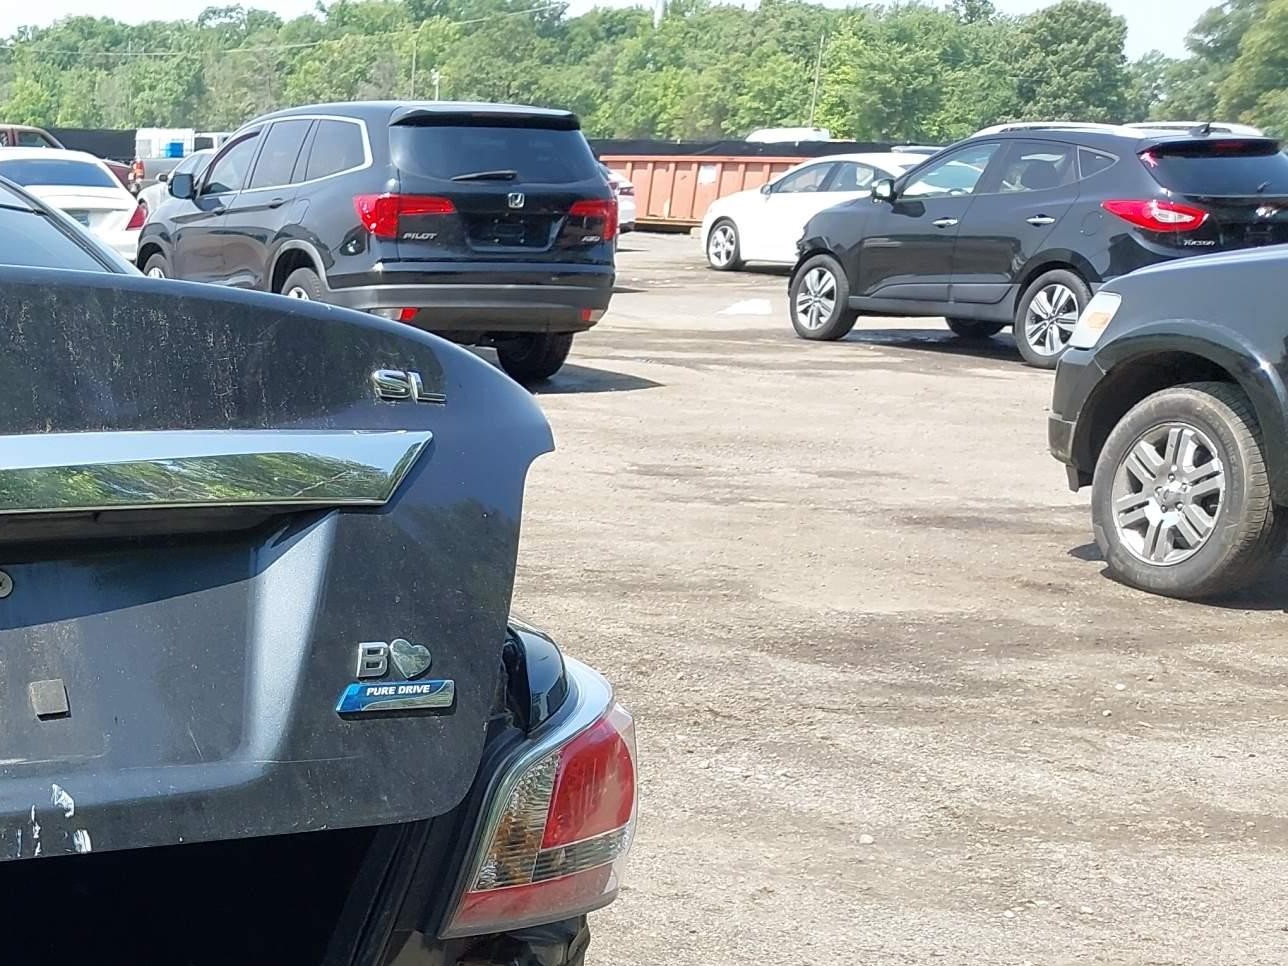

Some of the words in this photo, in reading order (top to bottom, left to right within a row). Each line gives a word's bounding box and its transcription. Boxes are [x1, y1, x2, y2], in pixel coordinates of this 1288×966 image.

[402, 232, 438, 240] PILOT
[373, 369, 447, 404] SL
[366, 686, 396, 696] PURE
[398, 684, 431, 694] DRIVE
